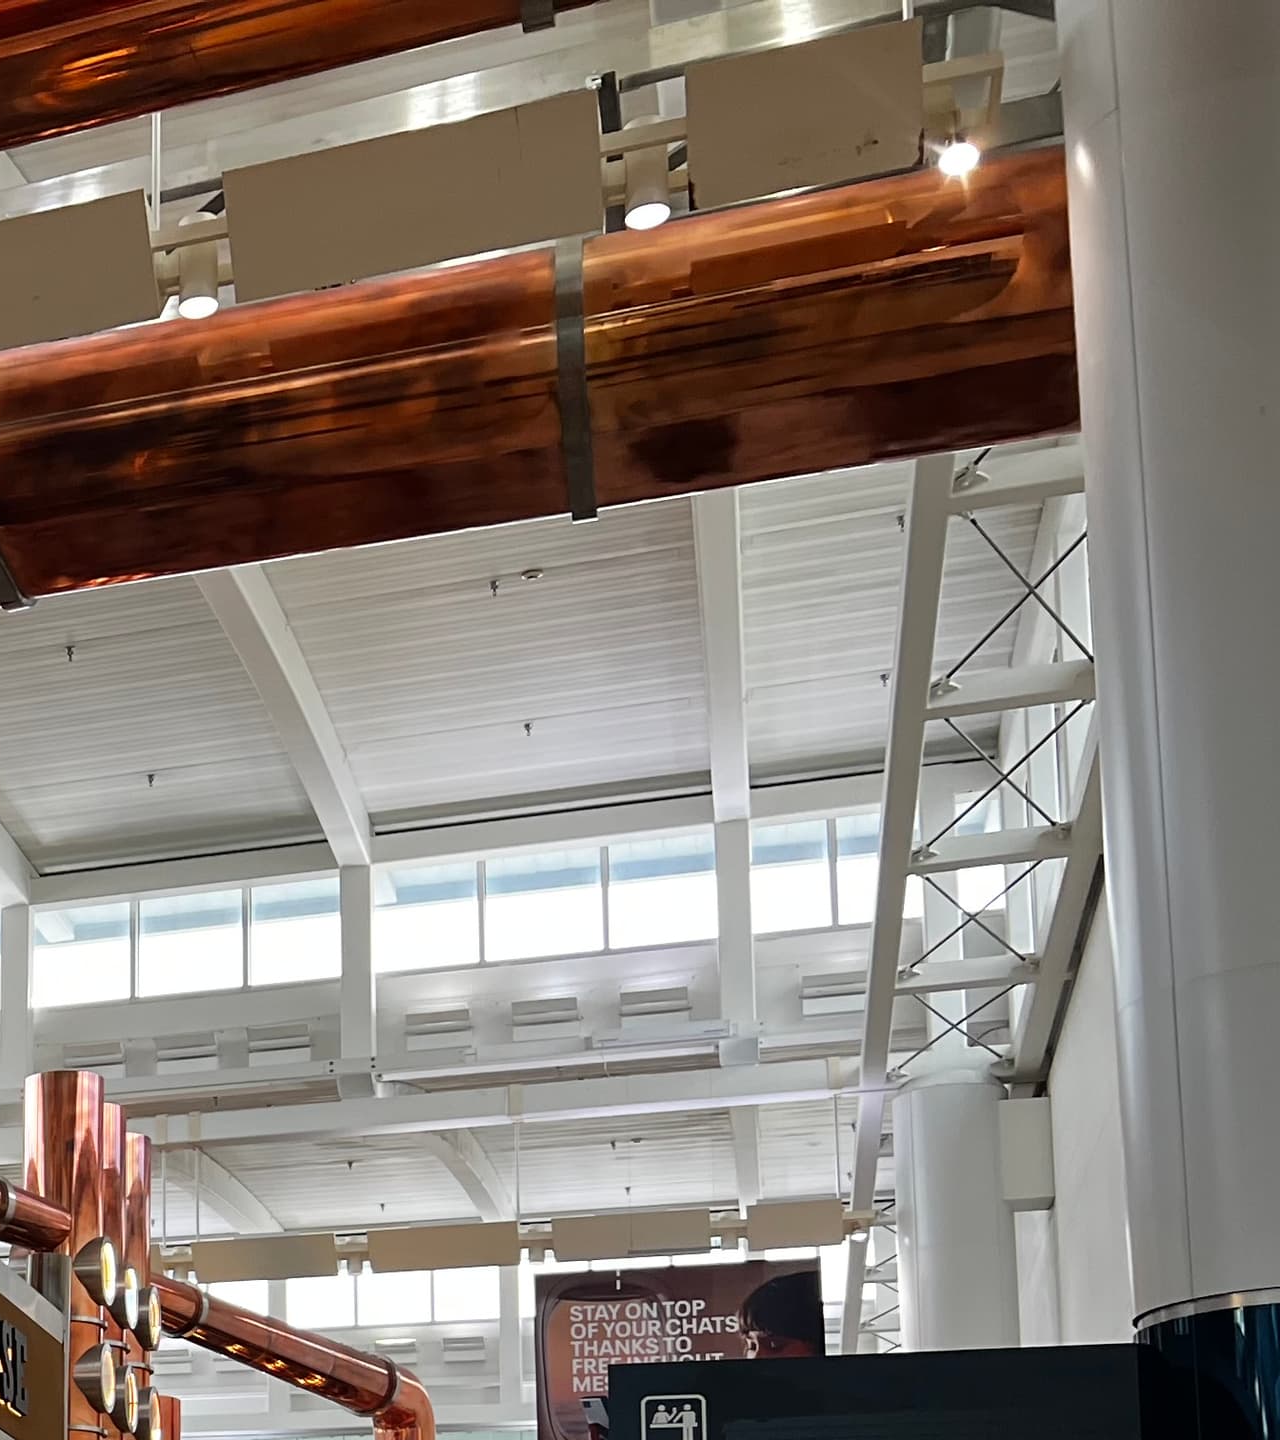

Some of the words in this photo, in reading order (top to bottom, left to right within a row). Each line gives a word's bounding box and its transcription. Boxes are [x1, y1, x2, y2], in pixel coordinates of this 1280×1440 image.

[569, 1303, 620, 1322] STAY
[625, 1302, 658, 1320] ON
[661, 1299, 706, 1318] TOP
[570, 1322, 600, 1340] OF
[602, 1320, 662, 1338] YOUR
[665, 1316, 740, 1336] CHATS
[570, 1338, 660, 1358] THANKS
[662, 1335, 692, 1353] TO
